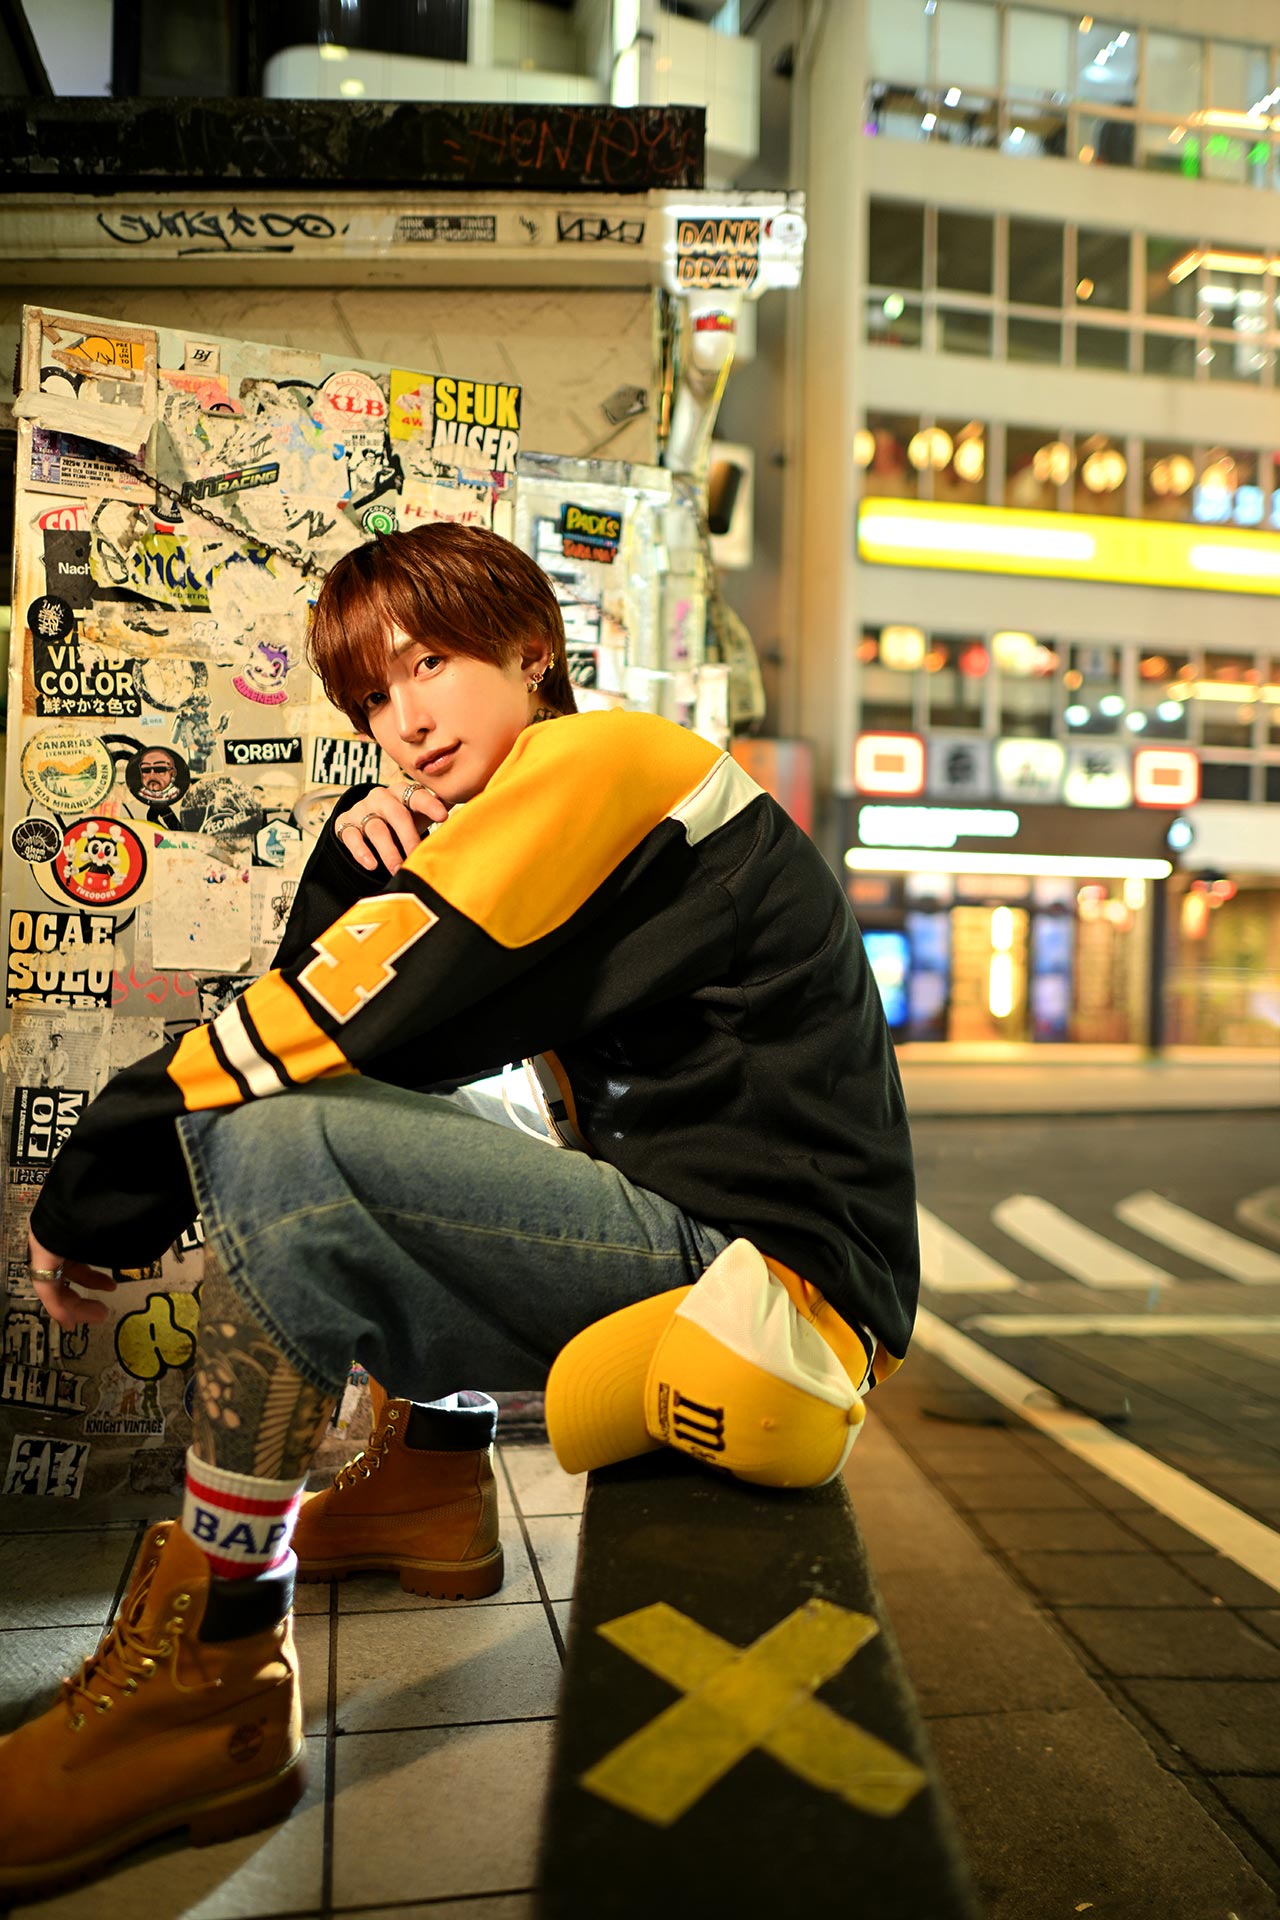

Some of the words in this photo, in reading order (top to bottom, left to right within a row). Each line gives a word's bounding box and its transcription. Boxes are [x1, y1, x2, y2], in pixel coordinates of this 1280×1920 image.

[678, 220, 759, 255] DANK
[678, 255, 758, 288] DRAW
[435, 377, 519, 429] SEUK
[217, 470, 277, 495] RACING
[58, 562, 91, 575] Nach
[41, 671, 135, 696] COLOR
[43, 697, 138, 715] 鮮やかな色で
[36, 739, 93, 751] CANARIAS
[314, 737, 379, 785] KARA
[53, 796, 94, 809] MIRANDA
[297, 892, 440, 1025] 4
[85, 1420, 123, 1433] KNIGHT
[123, 1420, 163, 1433] VINTAGE
